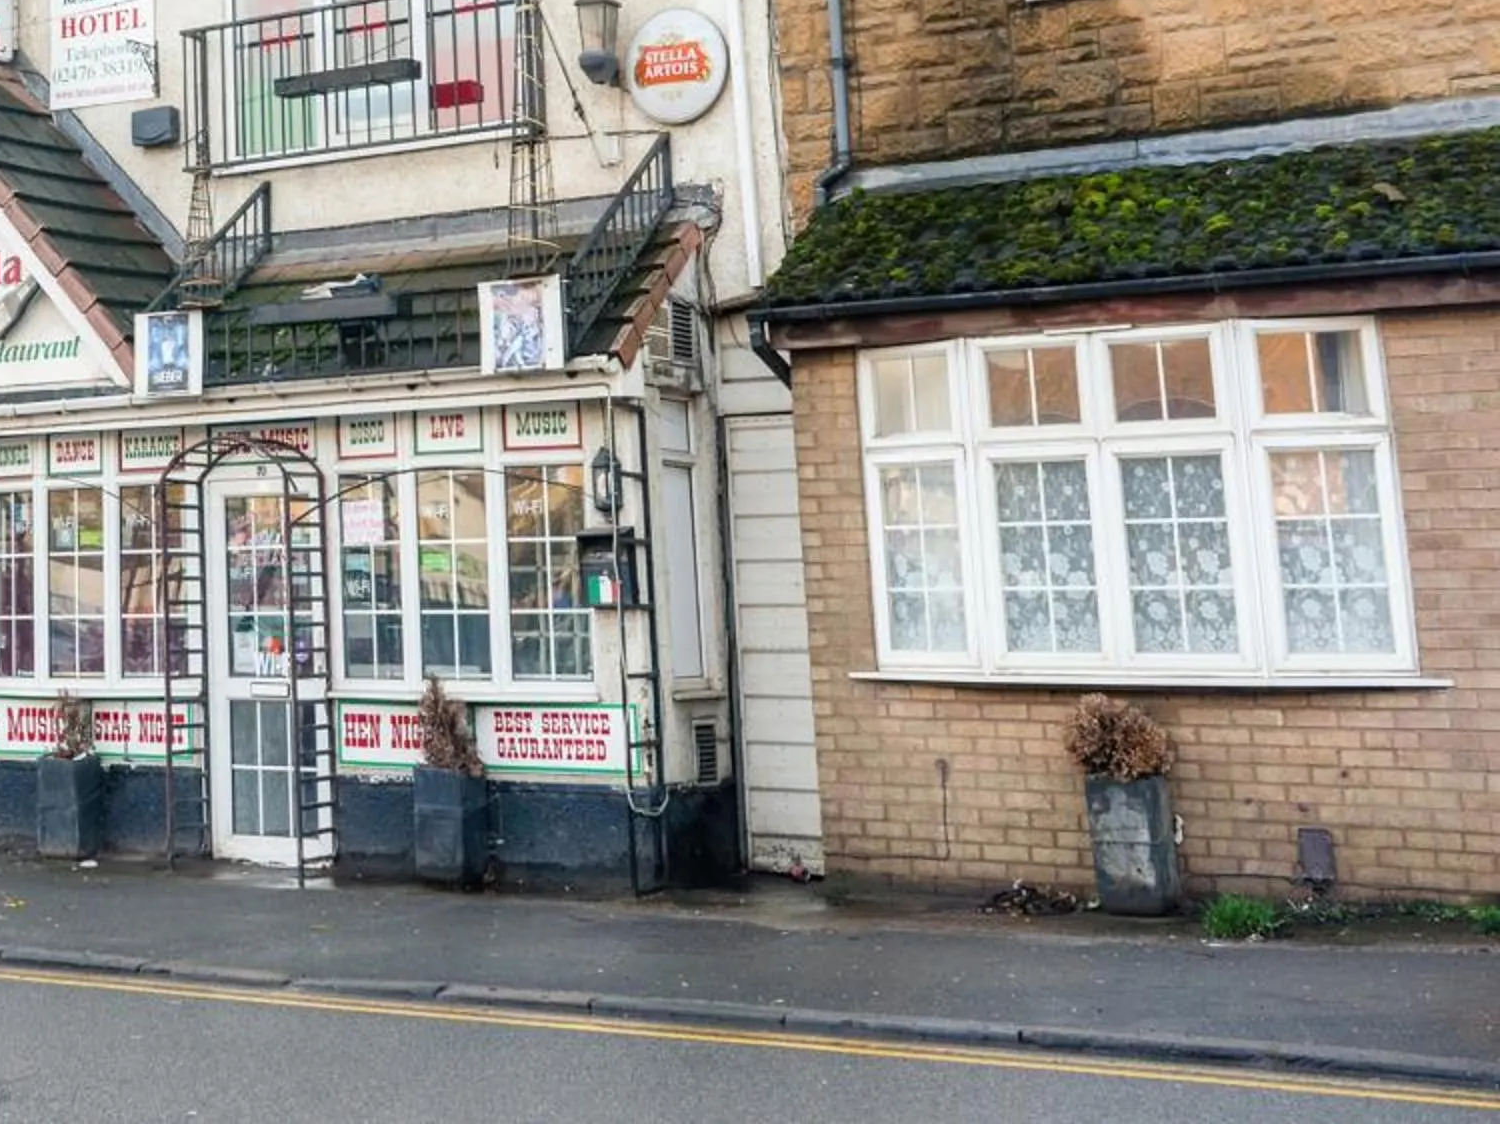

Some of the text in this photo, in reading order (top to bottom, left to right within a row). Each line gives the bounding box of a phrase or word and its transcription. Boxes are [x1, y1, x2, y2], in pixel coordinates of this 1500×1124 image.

[60, 7, 147, 39] HOTEL
[67, 40, 142, 63] Telephon
[644, 47, 698, 64] STELLA
[644, 62, 698, 79] ARTOIS
[351, 419, 385, 445] DISCO
[430, 413, 465, 440] LIVE
[516, 410, 568, 437] MUSIC
[56, 439, 95, 464] DANCE
[94, 710, 131, 742] STAG
[343, 713, 381, 749] HEN
[493, 711, 611, 736] BEST SERVICE
[497, 737, 608, 761] GAURANTEED
